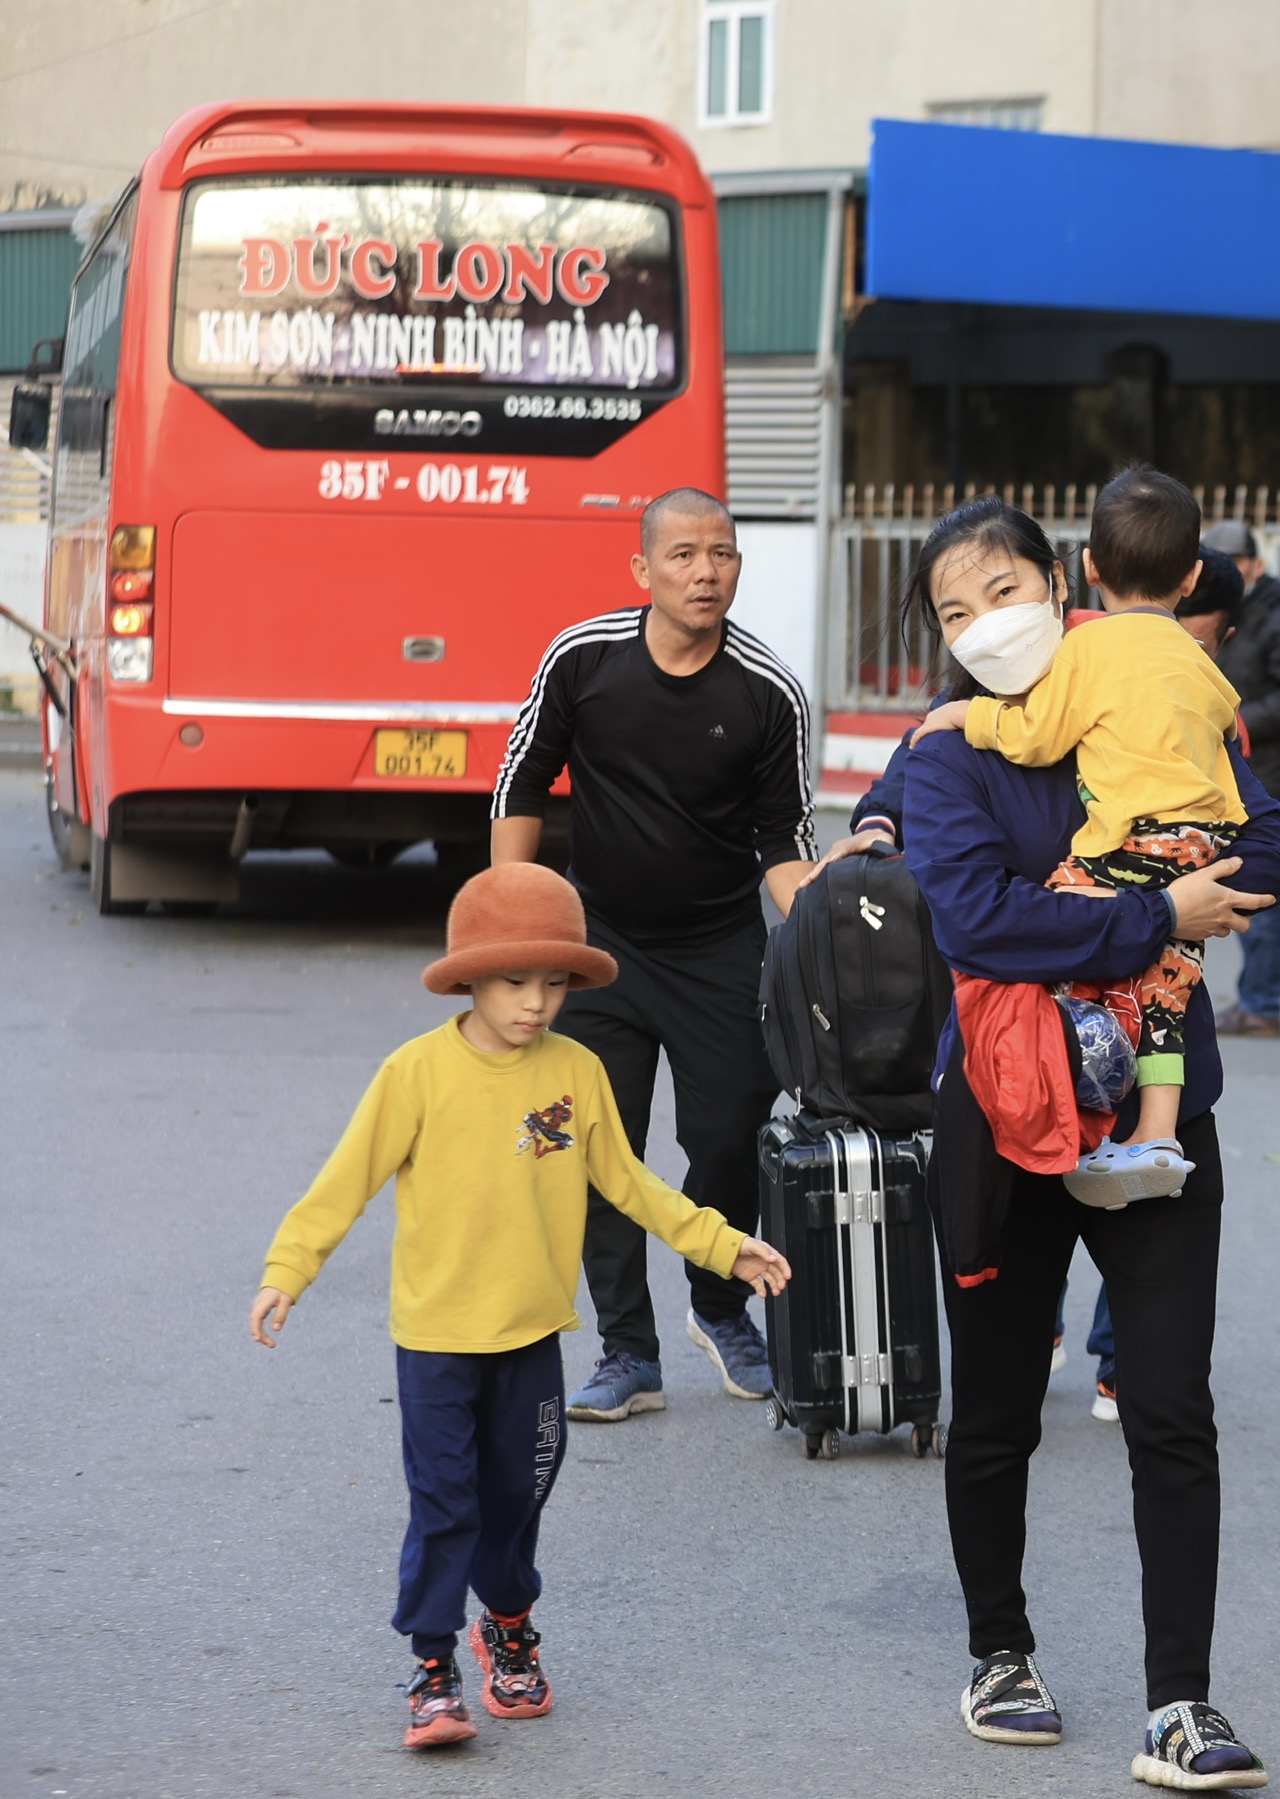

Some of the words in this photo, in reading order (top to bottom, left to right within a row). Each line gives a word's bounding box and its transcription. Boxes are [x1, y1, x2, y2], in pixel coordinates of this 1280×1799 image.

[239, 221, 397, 299] ĐỨC
[416, 239, 610, 306] LONG
[198, 309, 261, 366] KIM
[443, 303, 525, 375] BÌNH
[546, 307, 594, 377] HÀ
[599, 308, 659, 390] NỘI
[374, 408, 484, 437] SAMCO
[318, 458, 390, 501] 35F
[416, 462, 530, 505] 001.74
